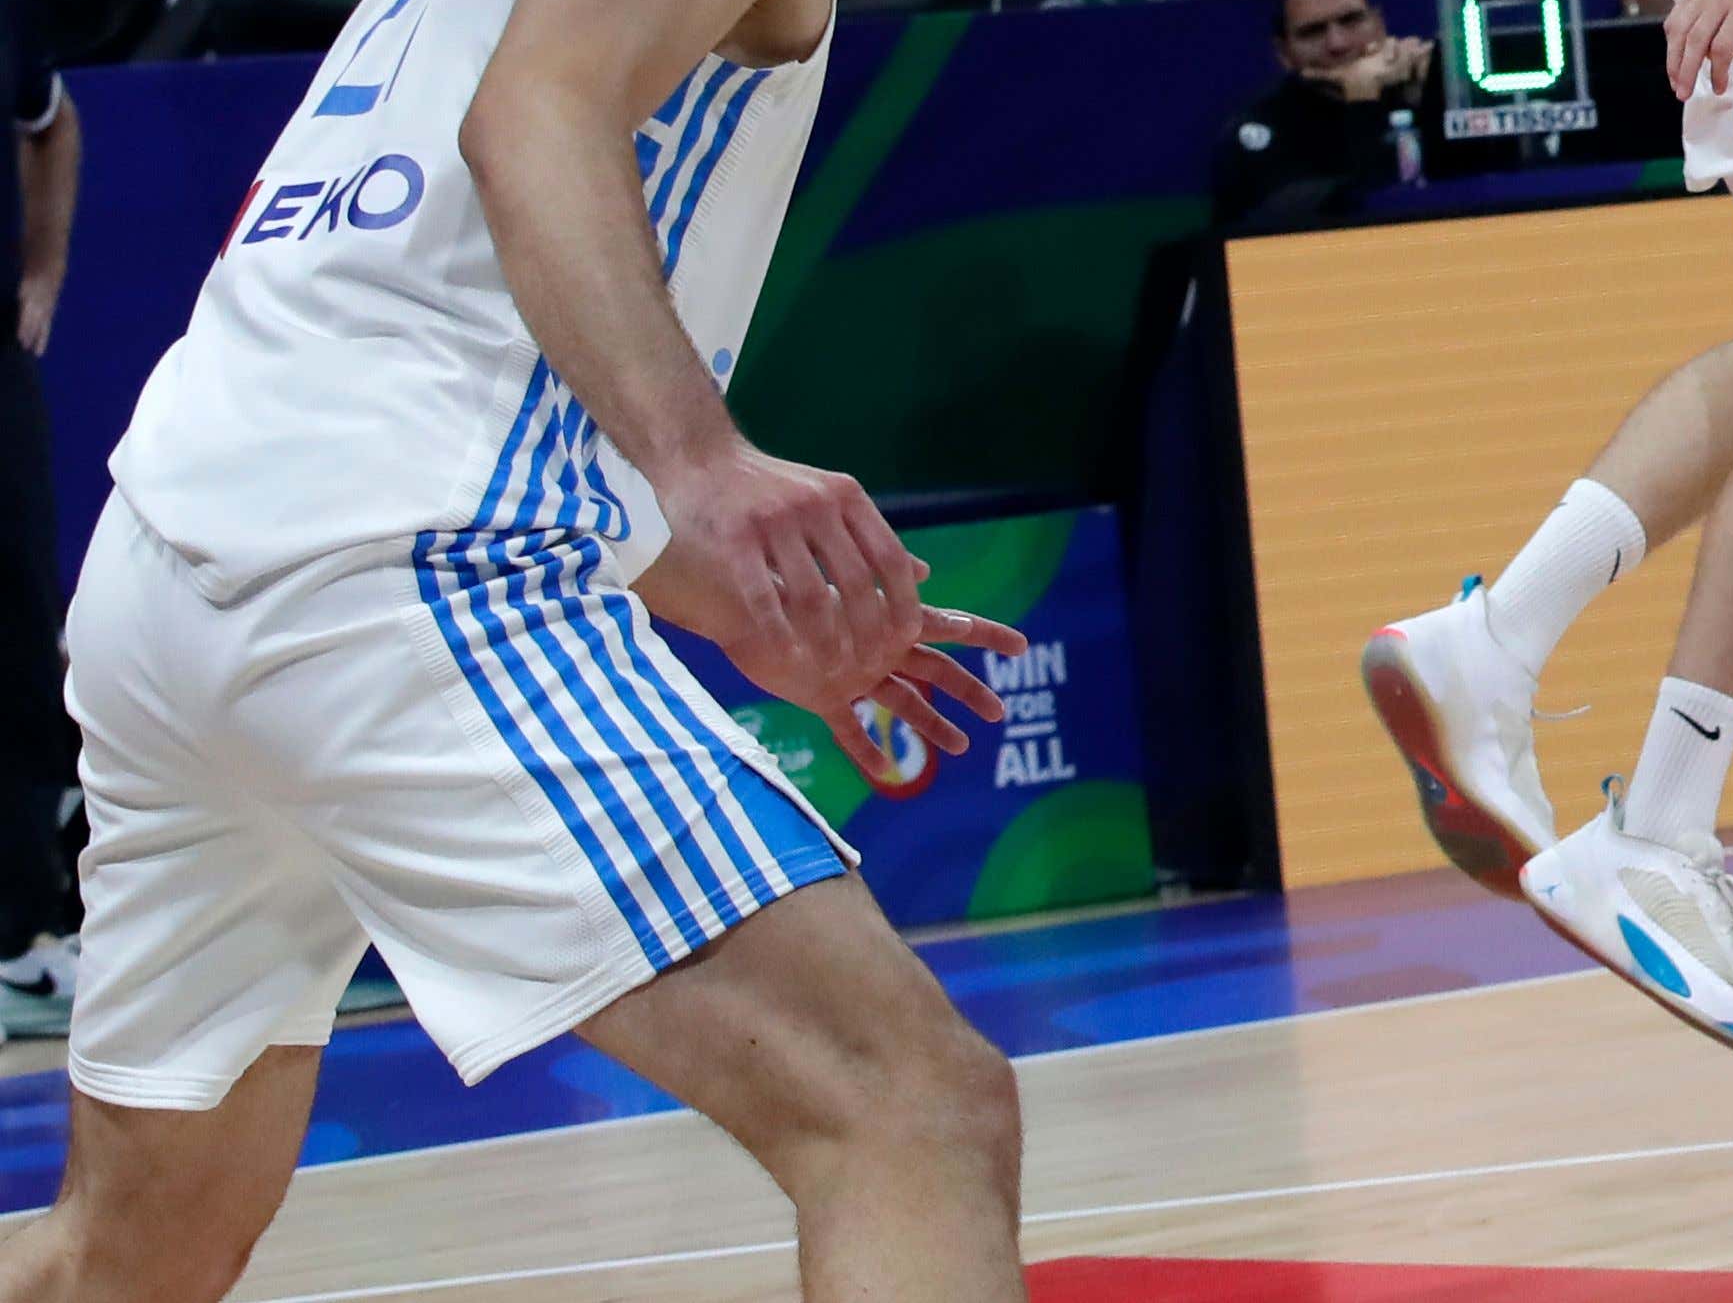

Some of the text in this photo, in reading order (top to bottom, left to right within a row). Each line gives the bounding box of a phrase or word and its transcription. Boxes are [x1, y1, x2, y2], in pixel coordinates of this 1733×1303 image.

[241, 154, 426, 244] EKO
[983, 642, 1067, 692] WIN
[994, 737, 1077, 788] ALL
